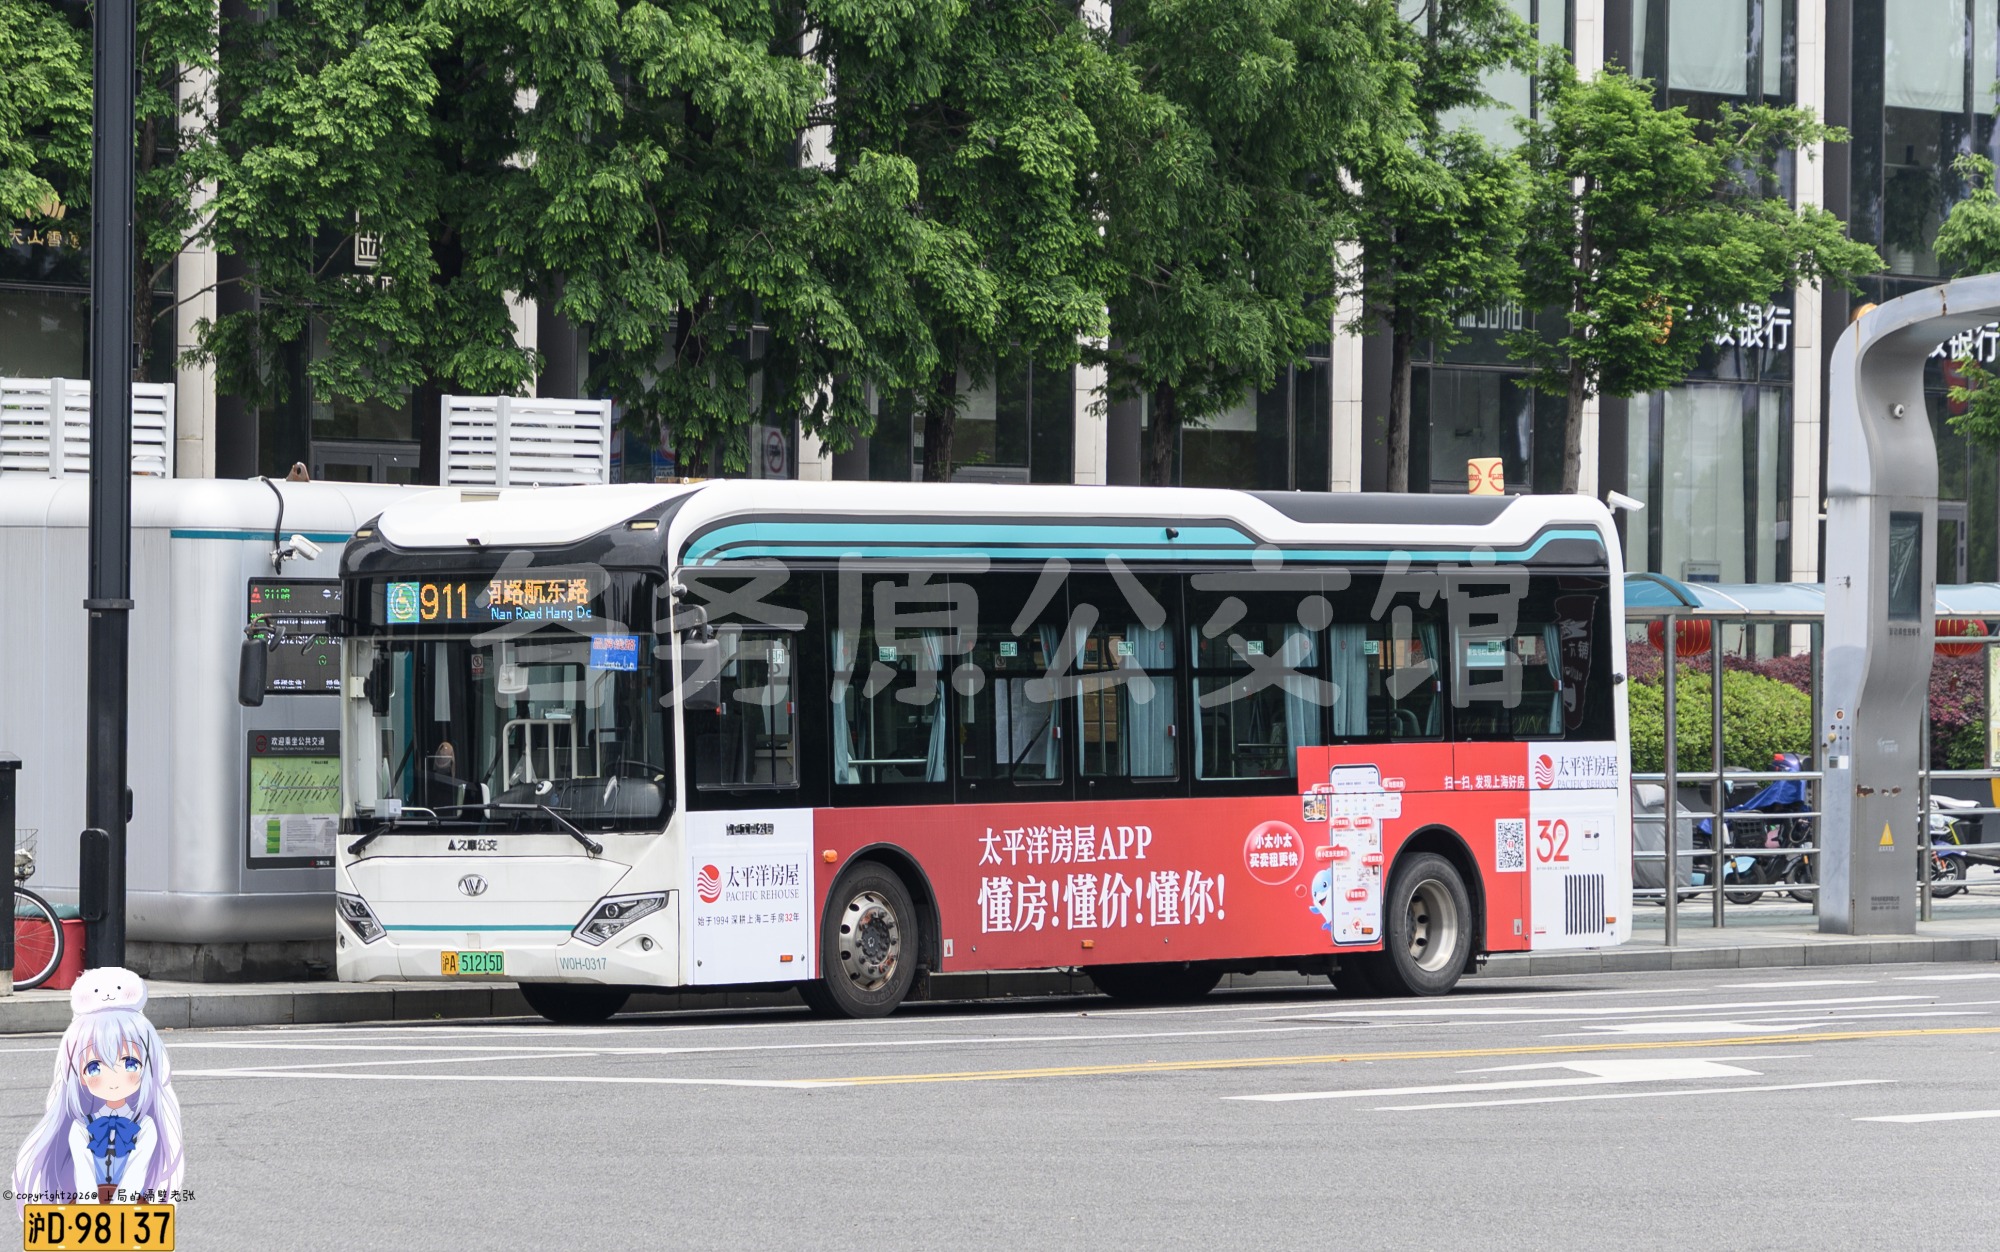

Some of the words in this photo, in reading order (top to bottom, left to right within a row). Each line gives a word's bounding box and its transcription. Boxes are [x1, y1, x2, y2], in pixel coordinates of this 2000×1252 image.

[420, 583, 467, 619] 911
[491, 608, 512, 620] Nan
[516, 607, 542, 619] Road
[546, 607, 573, 621] Hang
[270, 736, 325, 746] 欢迎乘坐公共交通
[1557, 755, 1617, 777] 太平洋房屋
[978, 825, 1153, 866] 太平洋房屋APP
[1256, 833, 1292, 849] 小太小太
[1536, 818, 1569, 863] 32
[1250, 851, 1298, 868] 买卖租更快
[726, 864, 799, 887] 太平洋房屋
[726, 891, 758, 901] PACIFIC
[760, 889, 799, 900] REHOUSE
